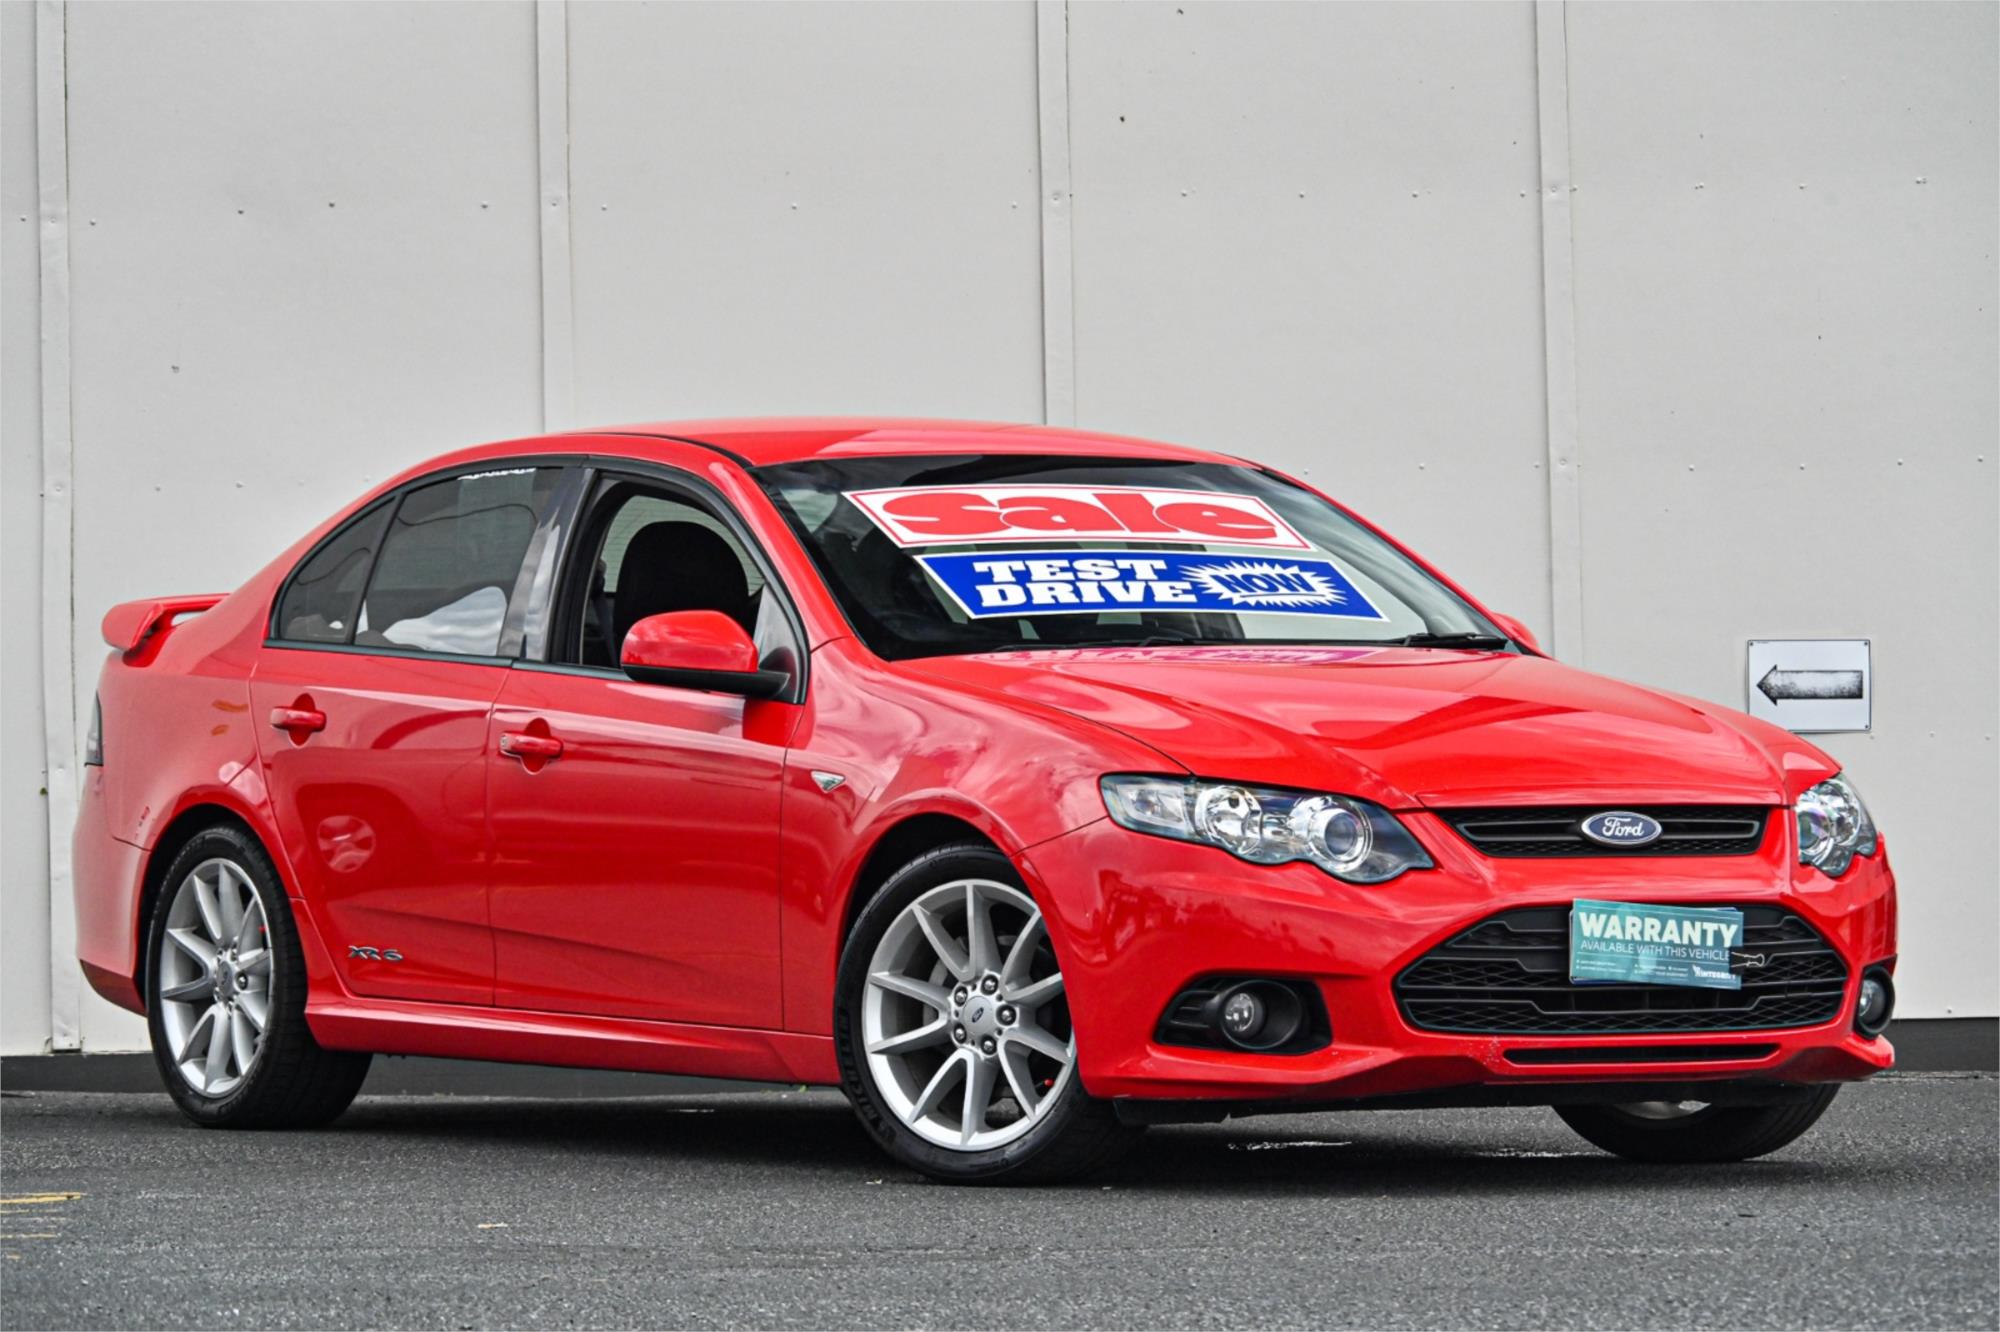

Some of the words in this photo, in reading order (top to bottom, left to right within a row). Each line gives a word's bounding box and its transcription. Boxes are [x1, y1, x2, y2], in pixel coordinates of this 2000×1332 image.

[883, 491, 1278, 539] Sale
[972, 558, 1167, 583] TEST
[980, 579, 1198, 607] DRIVE
[1208, 572, 1318, 594] NOW
[1602, 815, 1645, 837] Ford
[1578, 911, 1739, 949] WARRANTY
[347, 944, 404, 961] XR6
[1580, 940, 1635, 954] AVAILABLE
[1636, 944, 1663, 956] WITH
[1664, 945, 1688, 958] THIS
[1688, 948, 1730, 961] VEHICLE
